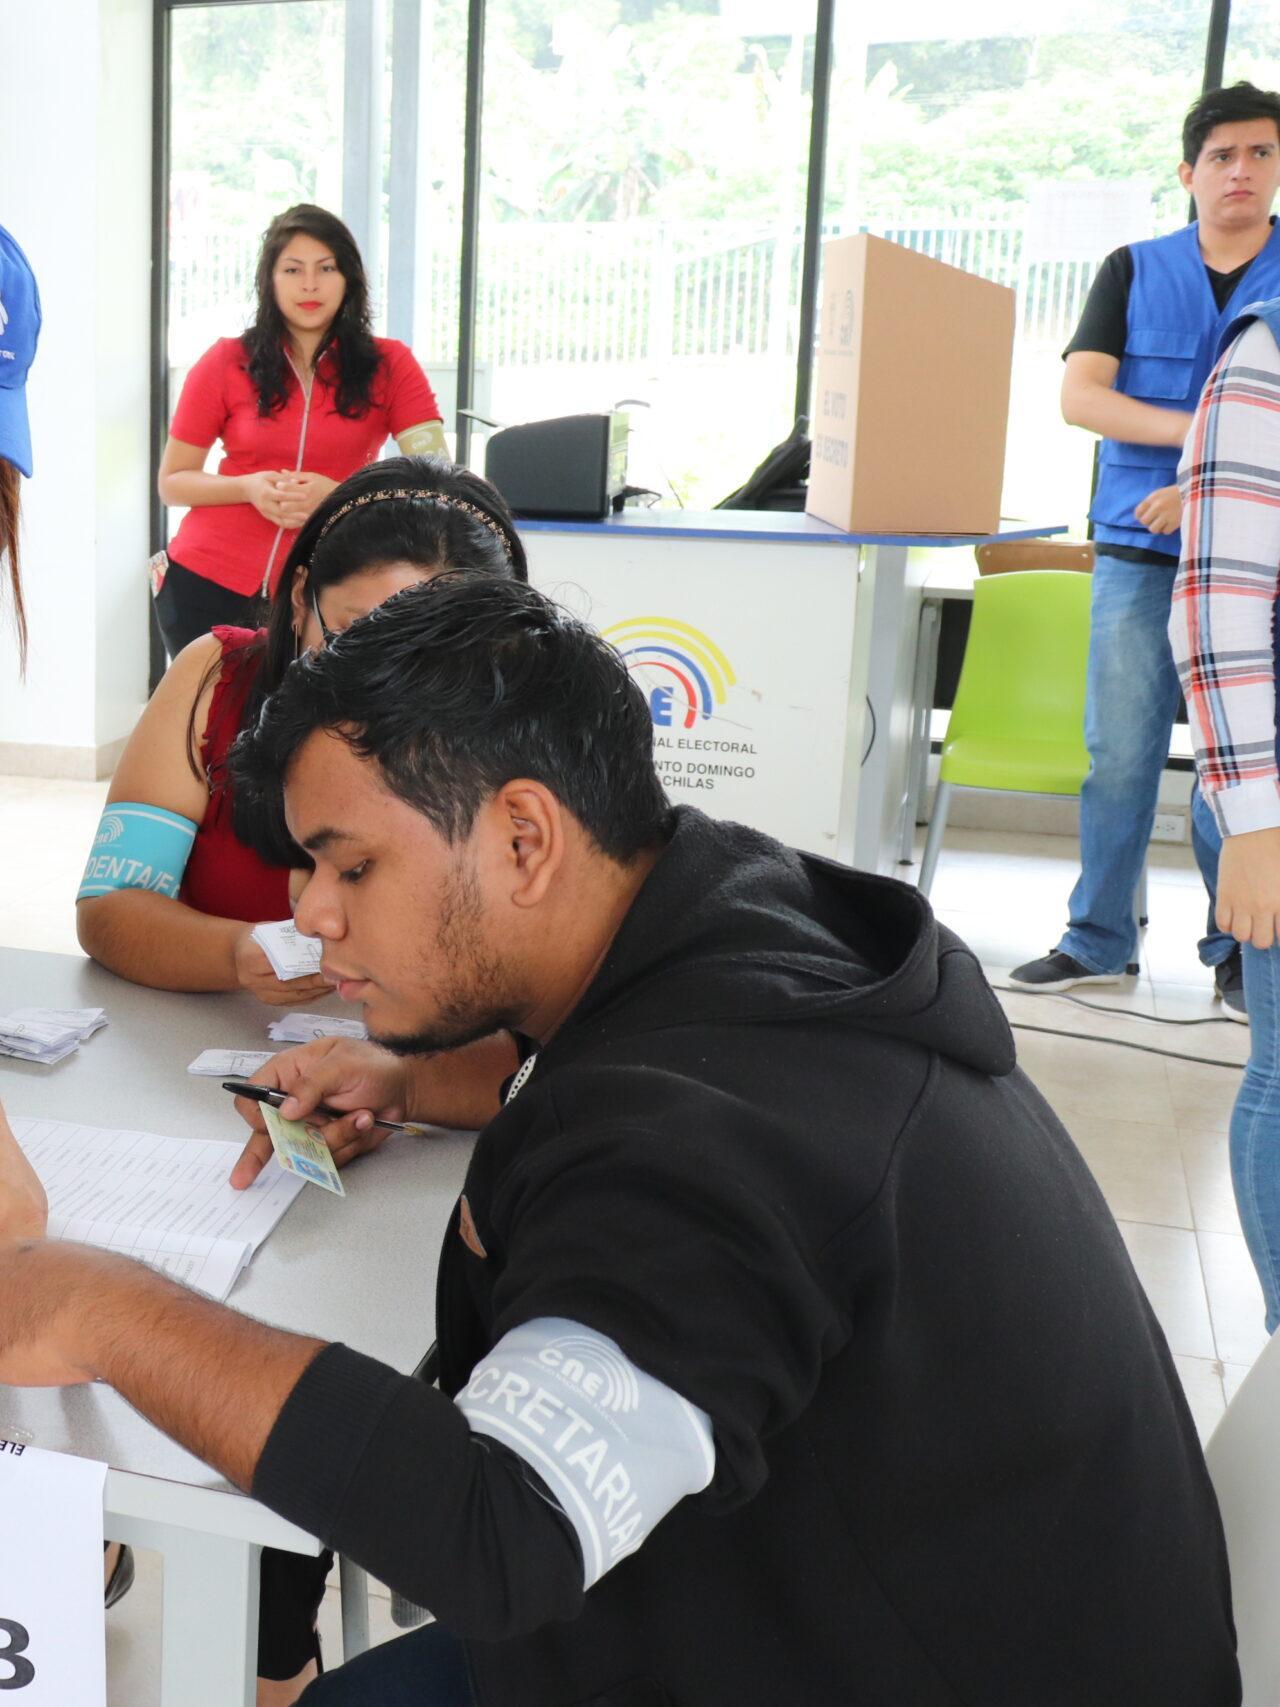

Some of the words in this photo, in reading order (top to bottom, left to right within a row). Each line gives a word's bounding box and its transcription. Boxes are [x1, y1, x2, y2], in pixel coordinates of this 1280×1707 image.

[678, 738, 758, 755] ELECTORAL
[687, 762, 755, 778] DOMINGO
[663, 775, 714, 790] CHILAS
[538, 1347, 604, 1397] CNE
